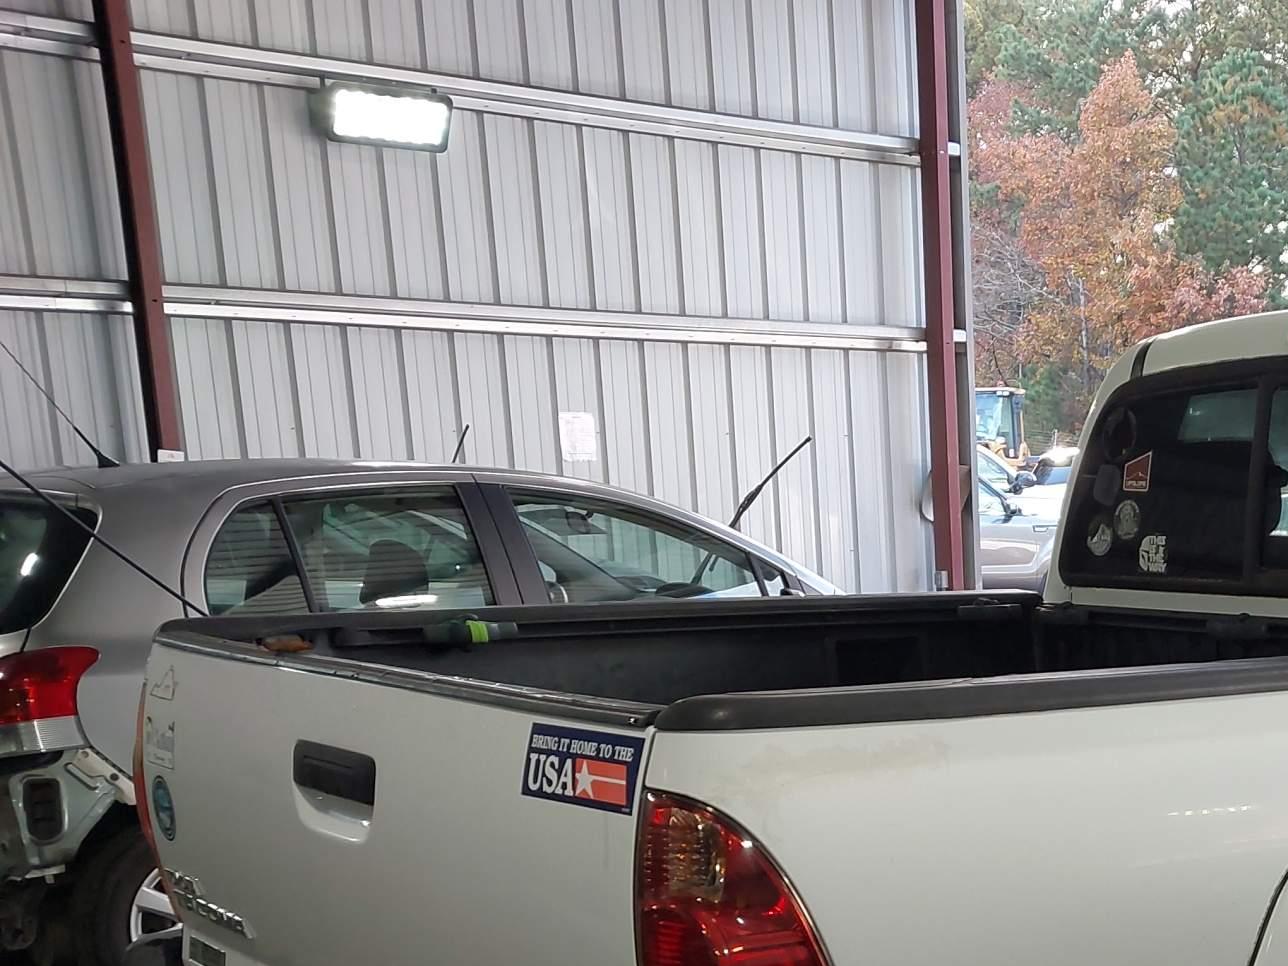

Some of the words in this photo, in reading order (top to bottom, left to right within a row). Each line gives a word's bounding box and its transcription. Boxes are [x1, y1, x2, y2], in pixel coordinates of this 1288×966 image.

[531, 734, 559, 751] BRING
[559, 738, 570, 752] IT
[569, 739, 598, 756] HOME
[600, 743, 613, 758] TO
[614, 745, 635, 762] THE
[527, 752, 574, 797] USA
